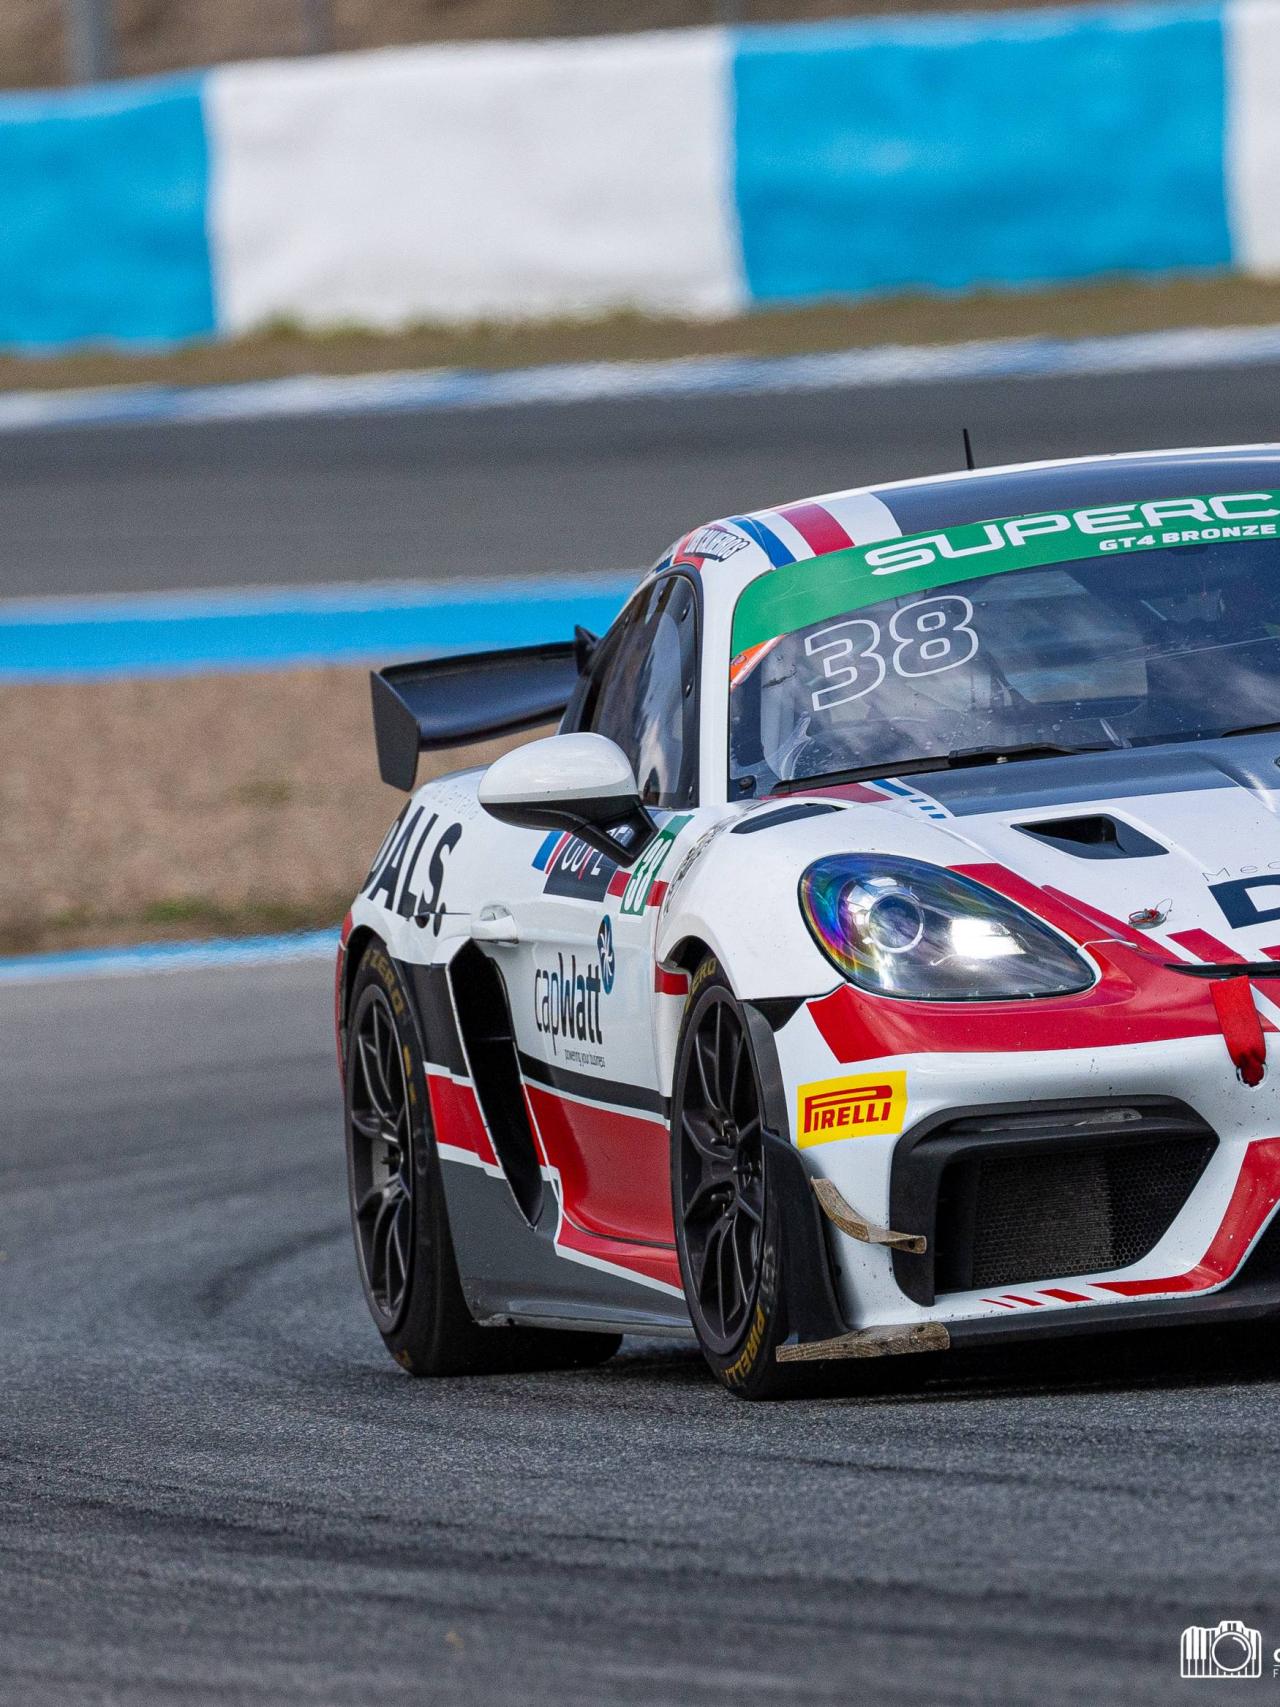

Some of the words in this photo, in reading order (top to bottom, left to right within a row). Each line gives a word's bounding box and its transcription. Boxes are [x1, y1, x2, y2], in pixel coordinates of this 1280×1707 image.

[1098, 533, 1155, 551] GT4
[1161, 523, 1277, 544] BRONZE
[804, 595, 979, 711] 38
[623, 838, 673, 912] 38
[535, 952, 603, 1056] capWatt
[803, 1085, 893, 1134] PIRELLI
